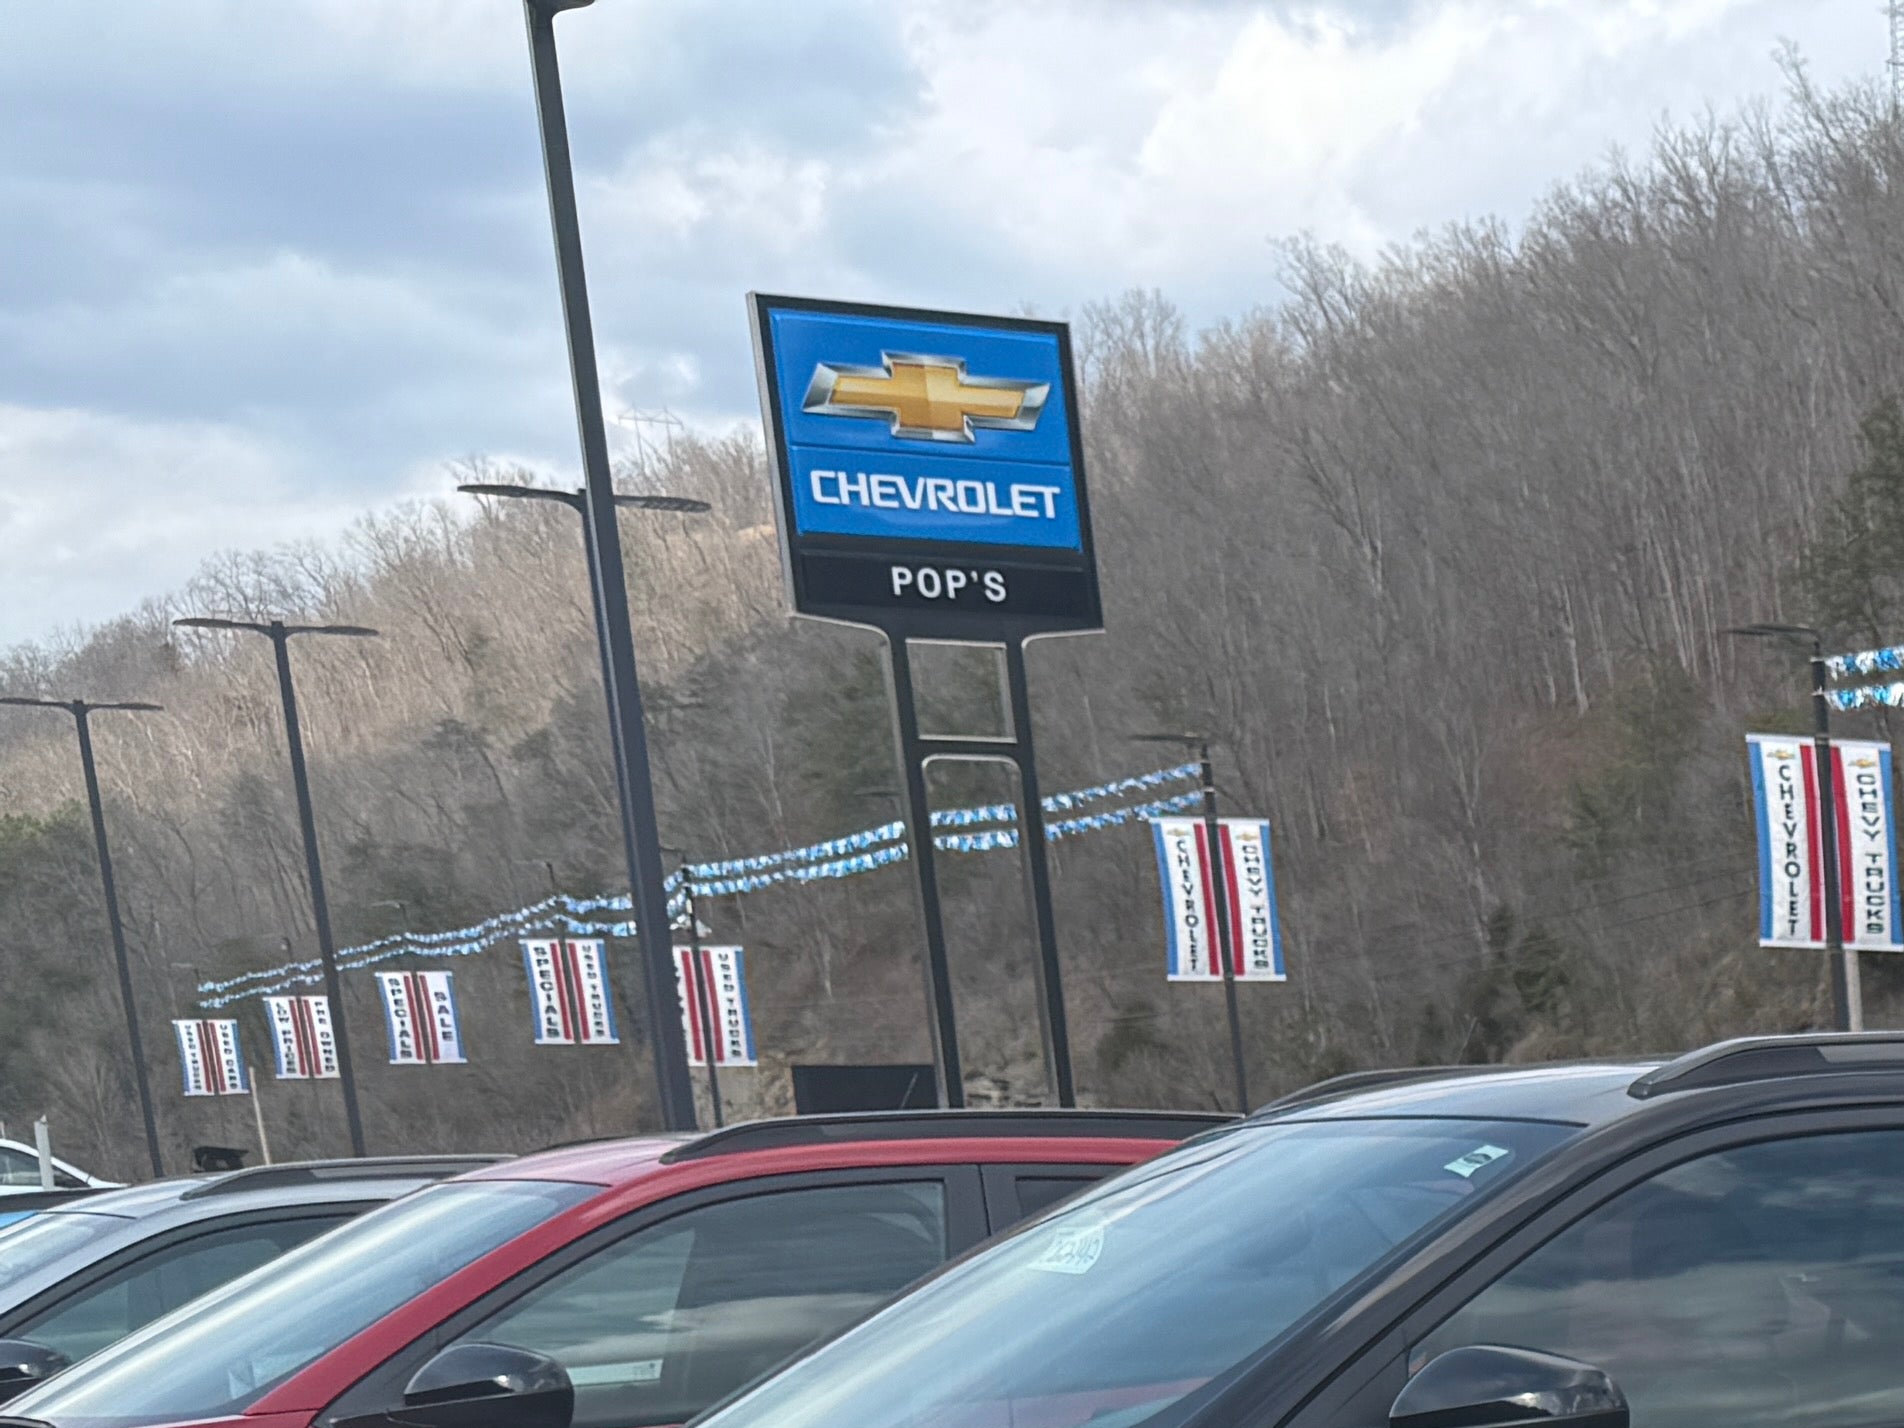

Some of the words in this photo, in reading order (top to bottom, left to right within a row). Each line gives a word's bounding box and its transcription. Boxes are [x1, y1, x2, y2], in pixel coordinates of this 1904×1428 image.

[810, 469, 1060, 519] CHEVROLET
[891, 566, 1007, 602] POP'S
[1856, 773, 1881, 840] CHEVY
[1242, 845, 1263, 897] CHEVY
[1778, 765, 1801, 936] CHEVROLET
[1176, 839, 1199, 971] CHEVROLET
[1865, 853, 1885, 934] TRUCKS
[533, 946, 560, 1038] SPECIALS
[718, 953, 735, 992] USED
[388, 978, 413, 1059] SPECIALS
[434, 991, 454, 1042] SALE
